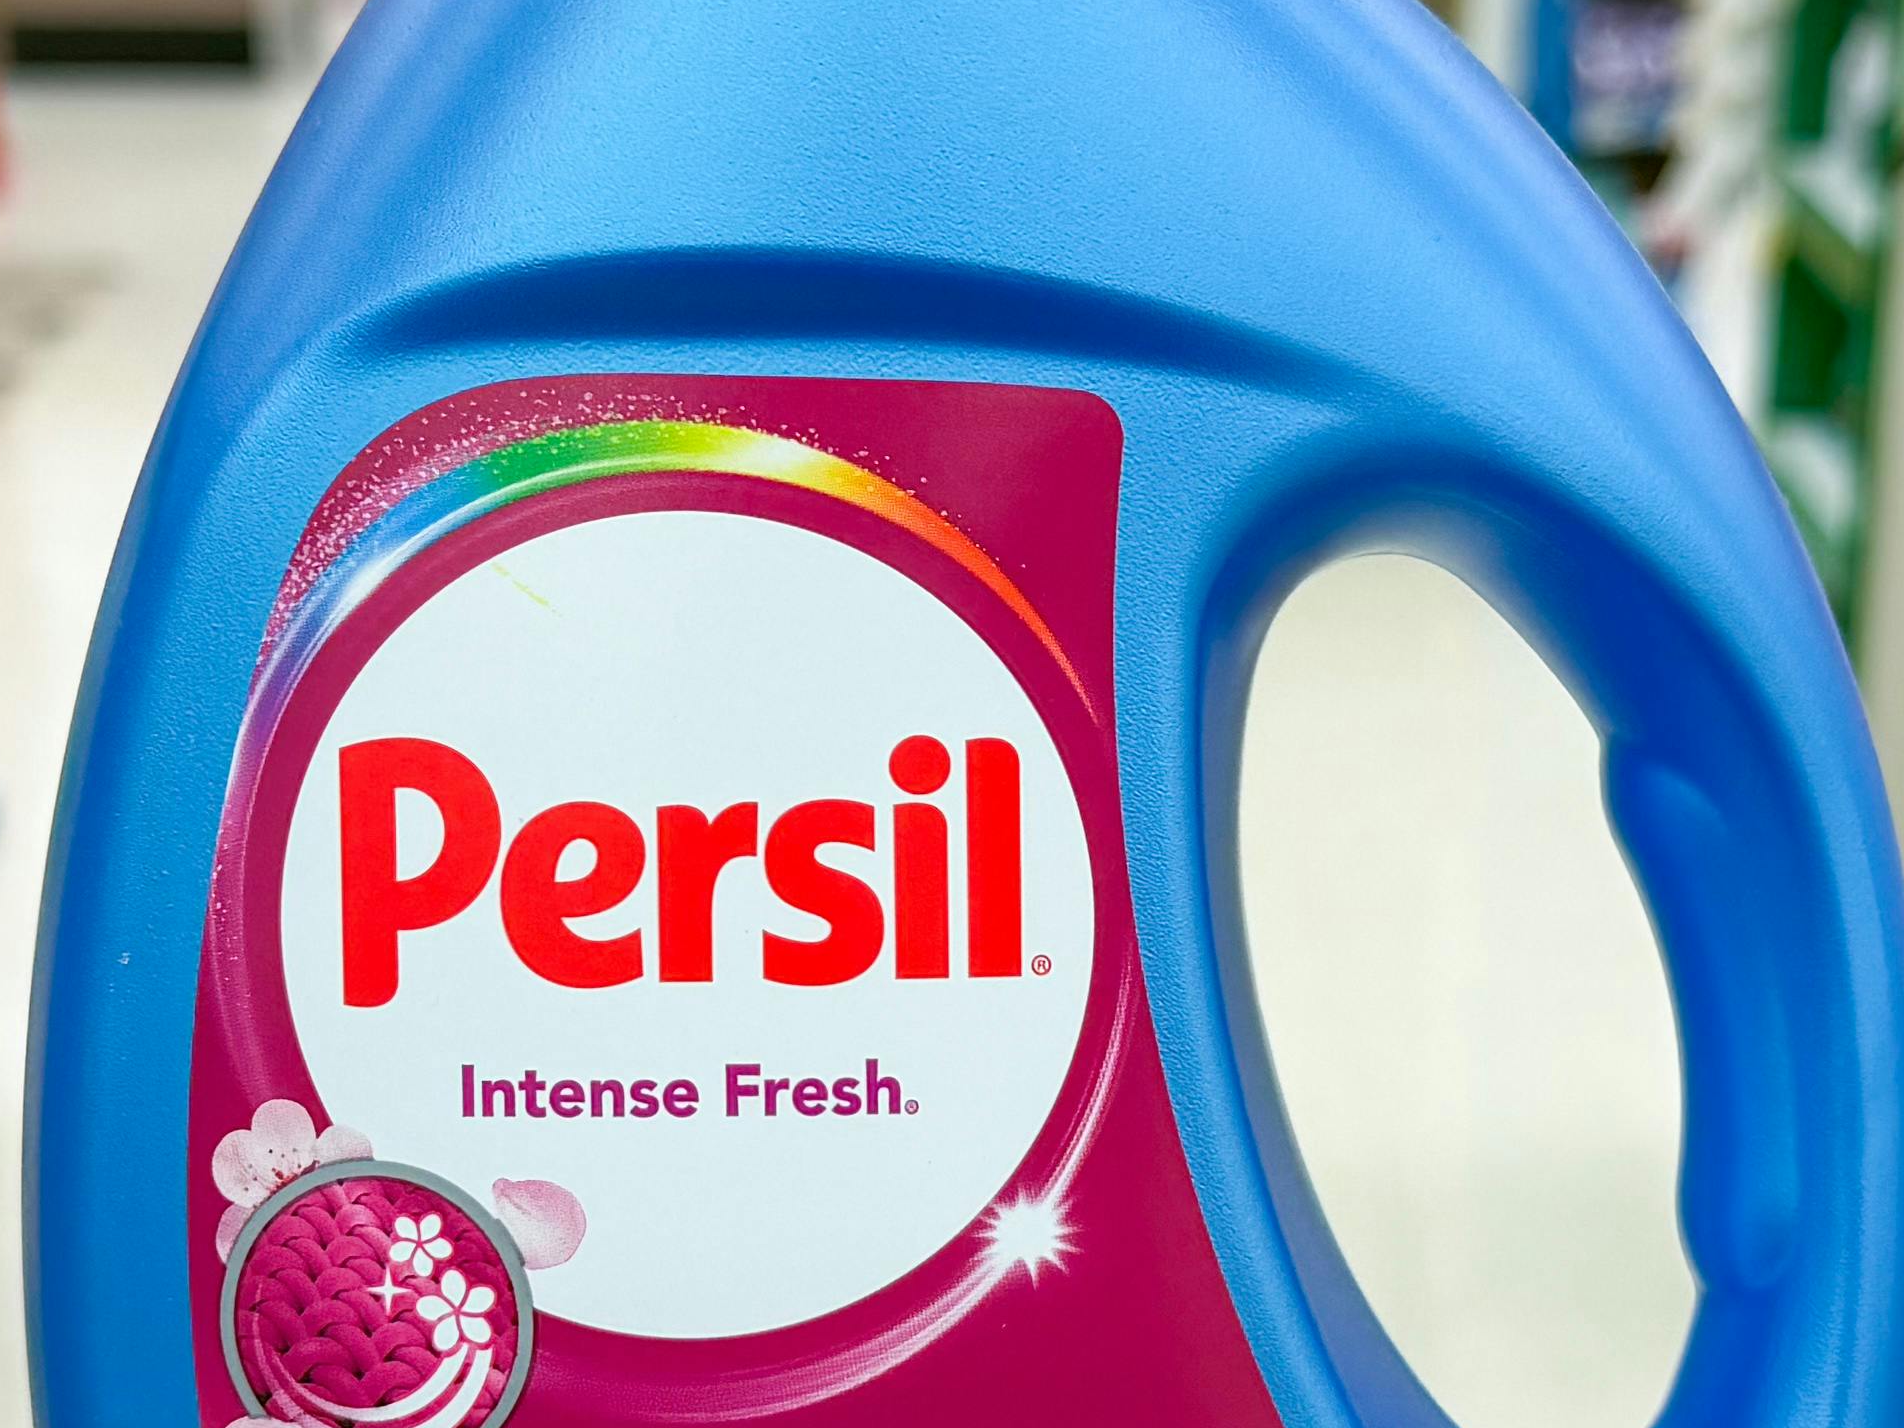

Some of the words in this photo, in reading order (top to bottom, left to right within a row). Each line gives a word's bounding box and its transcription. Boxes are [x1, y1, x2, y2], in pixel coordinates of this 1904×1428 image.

[339, 734, 1022, 1008] Persil
[461, 1064, 699, 1119] Intense
[725, 1058, 900, 1117] Fresh
